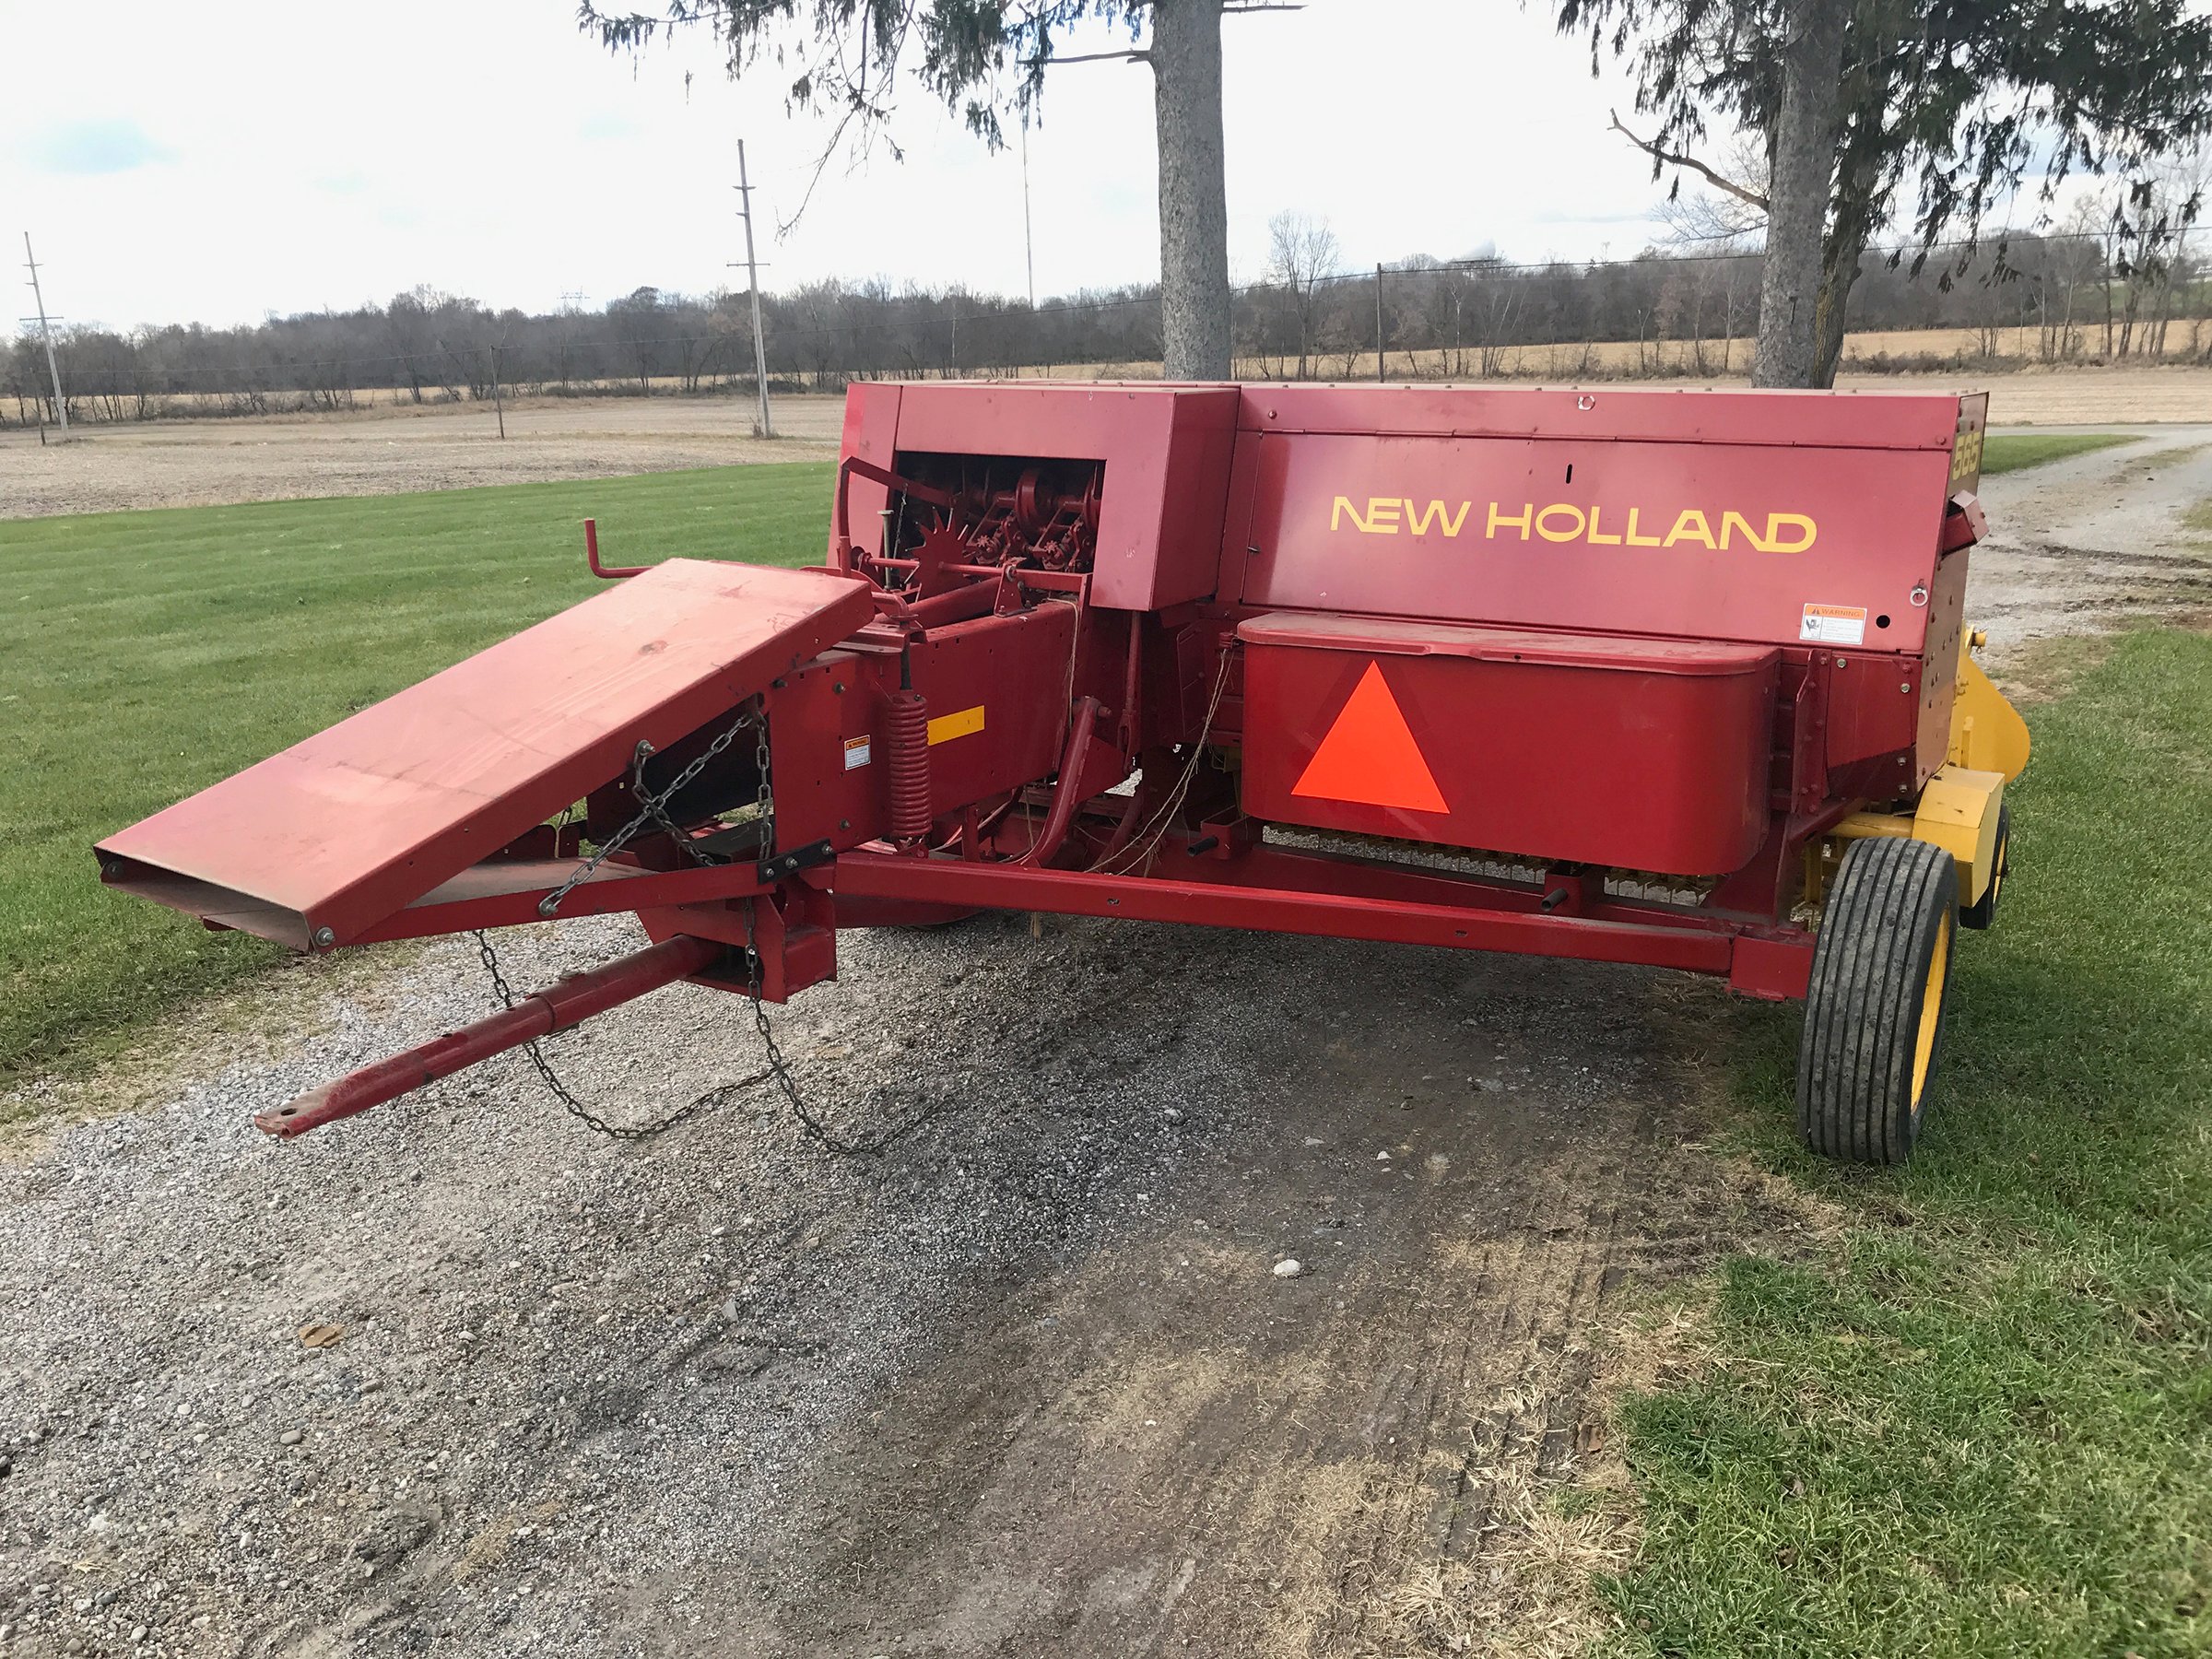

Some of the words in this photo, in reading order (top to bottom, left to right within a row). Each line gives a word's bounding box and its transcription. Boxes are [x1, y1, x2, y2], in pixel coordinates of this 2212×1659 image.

[1953, 431, 1981, 480] 565
[1331, 496, 1472, 538] NEW
[1486, 503, 1818, 554] HOLLAND
[1821, 608, 1861, 618] WARNING
